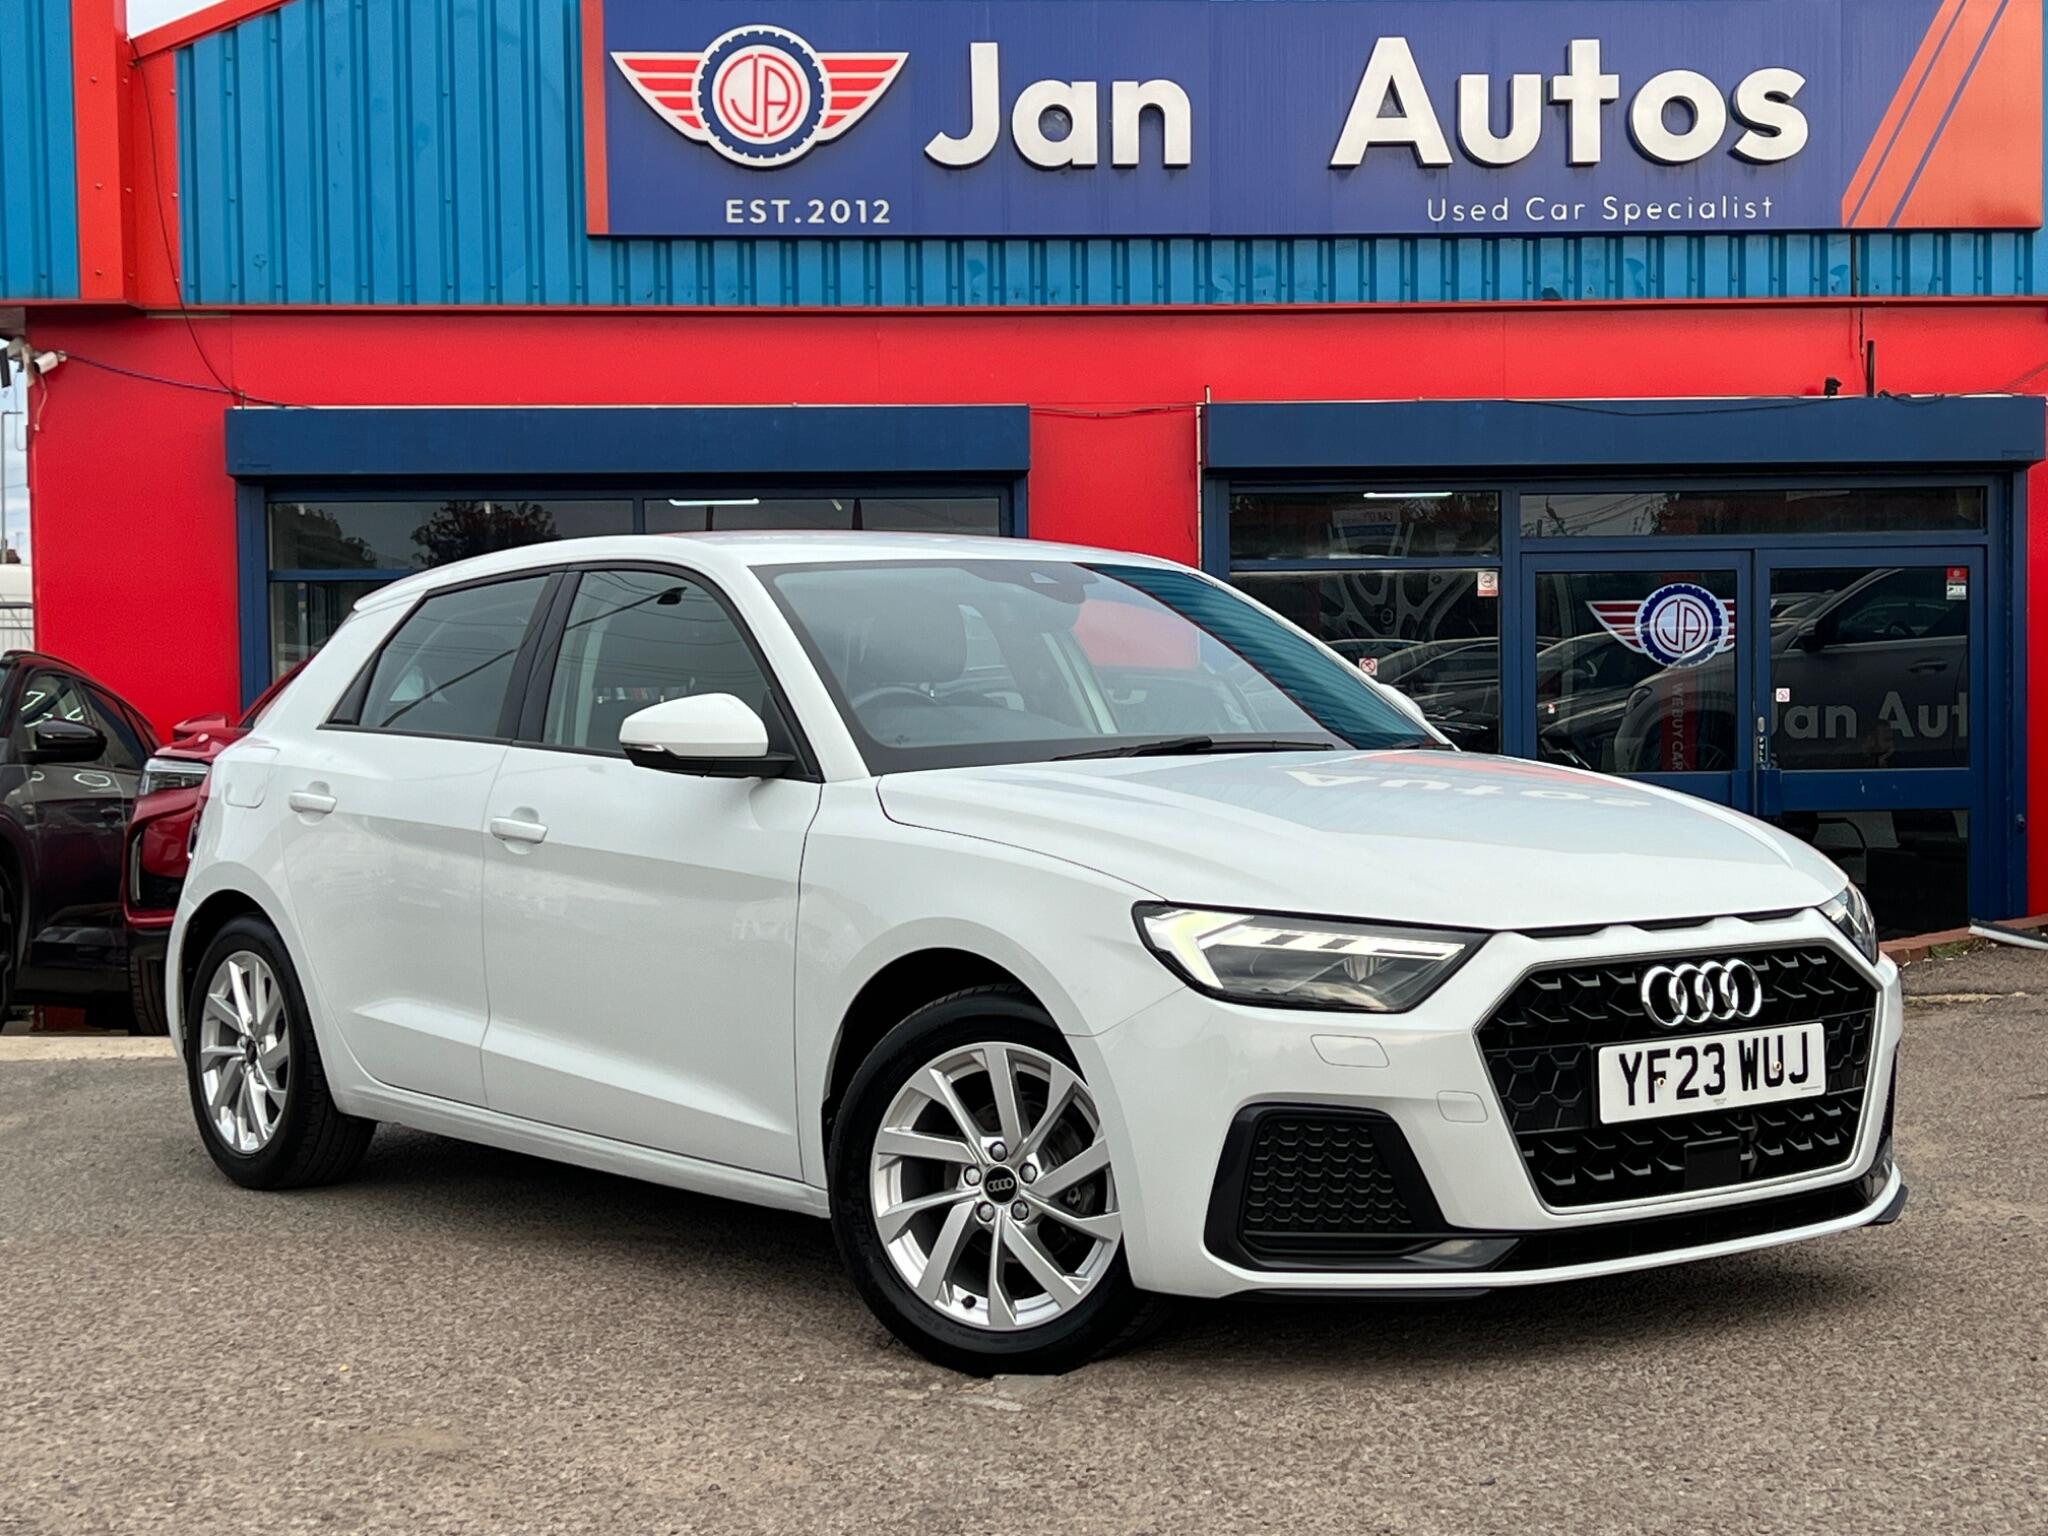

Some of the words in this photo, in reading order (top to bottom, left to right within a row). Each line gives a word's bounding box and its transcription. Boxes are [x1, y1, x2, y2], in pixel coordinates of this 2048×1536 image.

[925, 42, 1192, 166] Jan
[1331, 37, 1808, 164] Autos
[726, 199, 890, 224] EST.2012
[1427, 197, 1508, 222] Used
[1526, 197, 1586, 221] Car
[1602, 195, 1773, 226] Specialist
[1671, 683, 1684, 706] WE
[1671, 709, 1684, 737] BUY
[1618, 1042, 1726, 1107] YF23
[1738, 1031, 1809, 1092] WUJ
